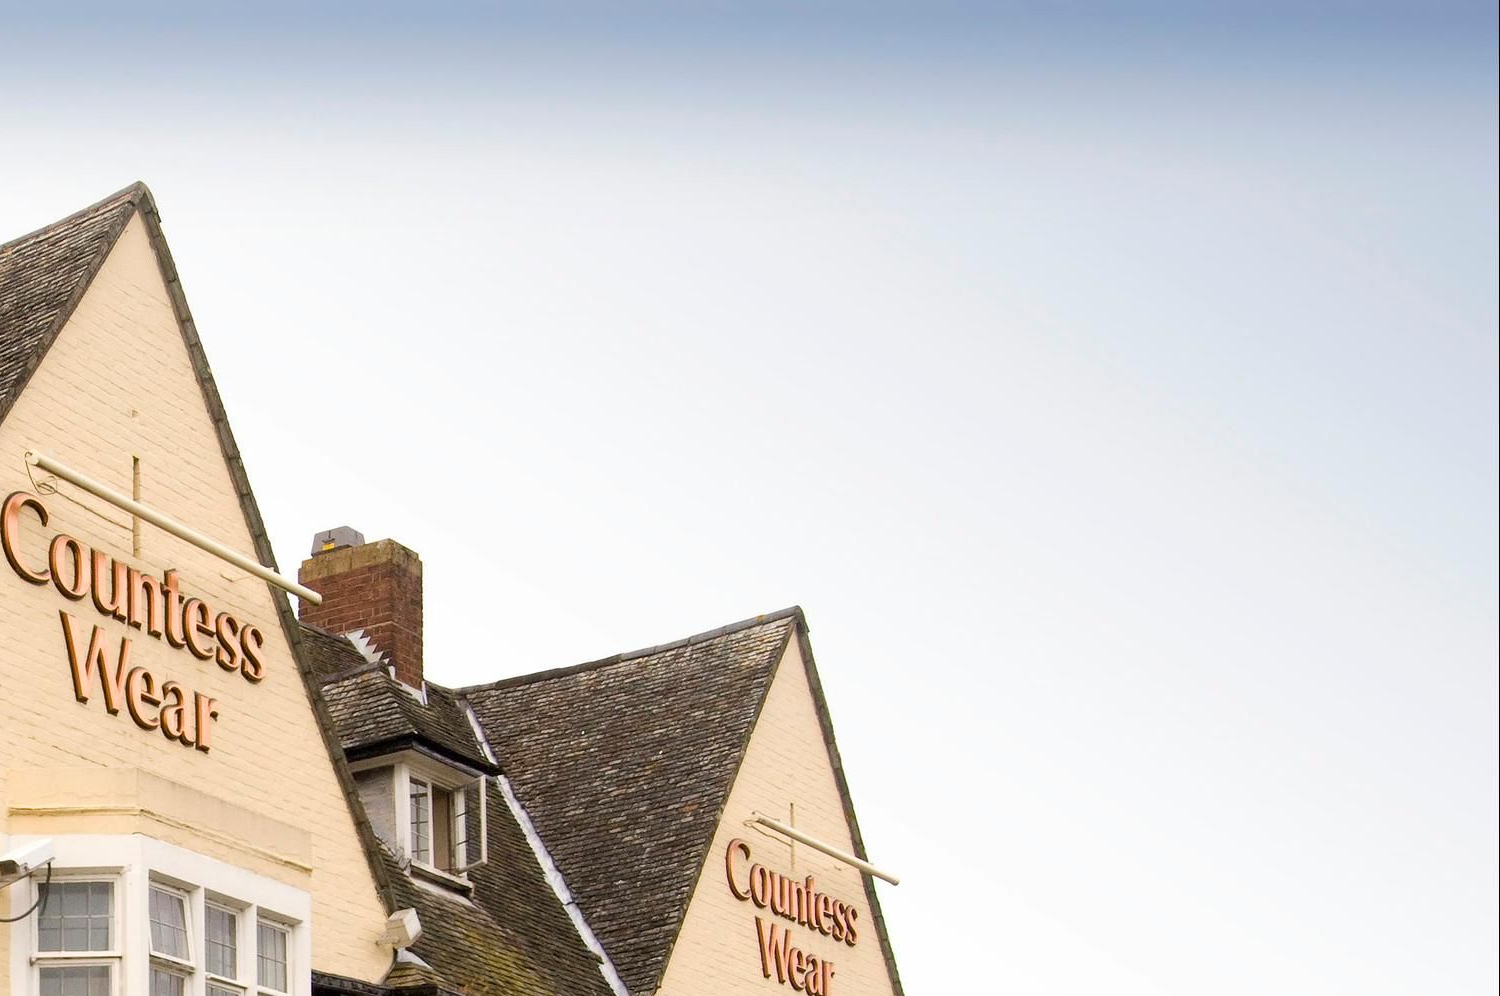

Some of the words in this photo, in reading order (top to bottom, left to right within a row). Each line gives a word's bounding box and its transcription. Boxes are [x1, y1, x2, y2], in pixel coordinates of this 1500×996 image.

[0, 491, 266, 684] Countess
[59, 609, 220, 754] Wear
[725, 838, 860, 947] Countess
